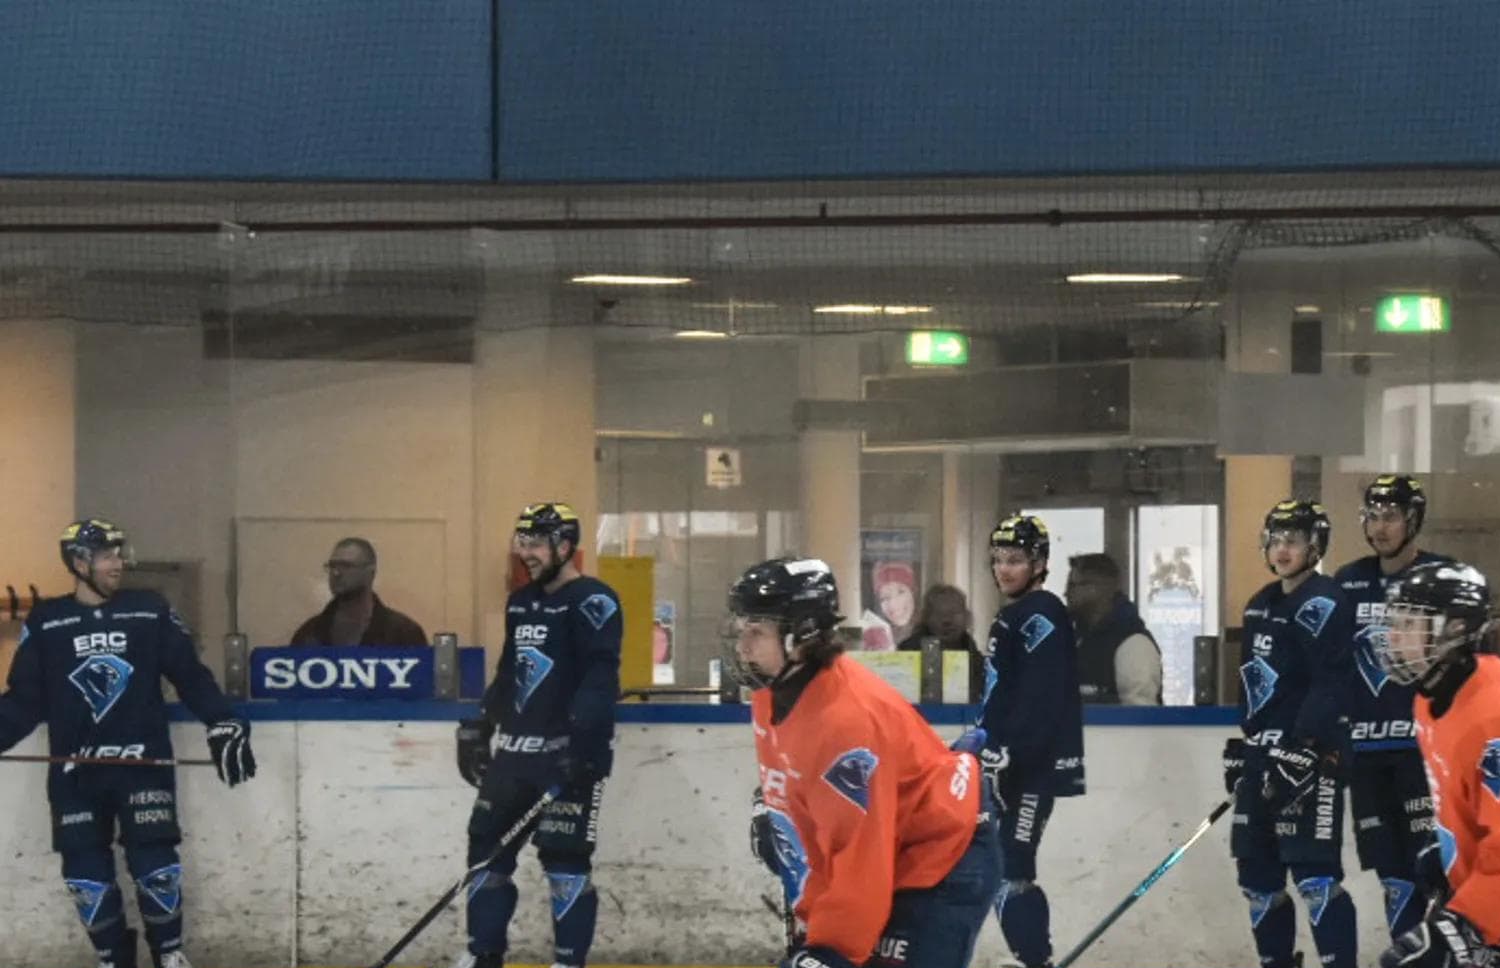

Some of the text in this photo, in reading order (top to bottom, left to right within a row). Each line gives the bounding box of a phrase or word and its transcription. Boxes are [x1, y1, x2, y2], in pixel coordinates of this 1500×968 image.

[73, 631, 128, 653] ERC
[264, 657, 420, 690] SONY
[1315, 776, 1336, 840] SATURN
